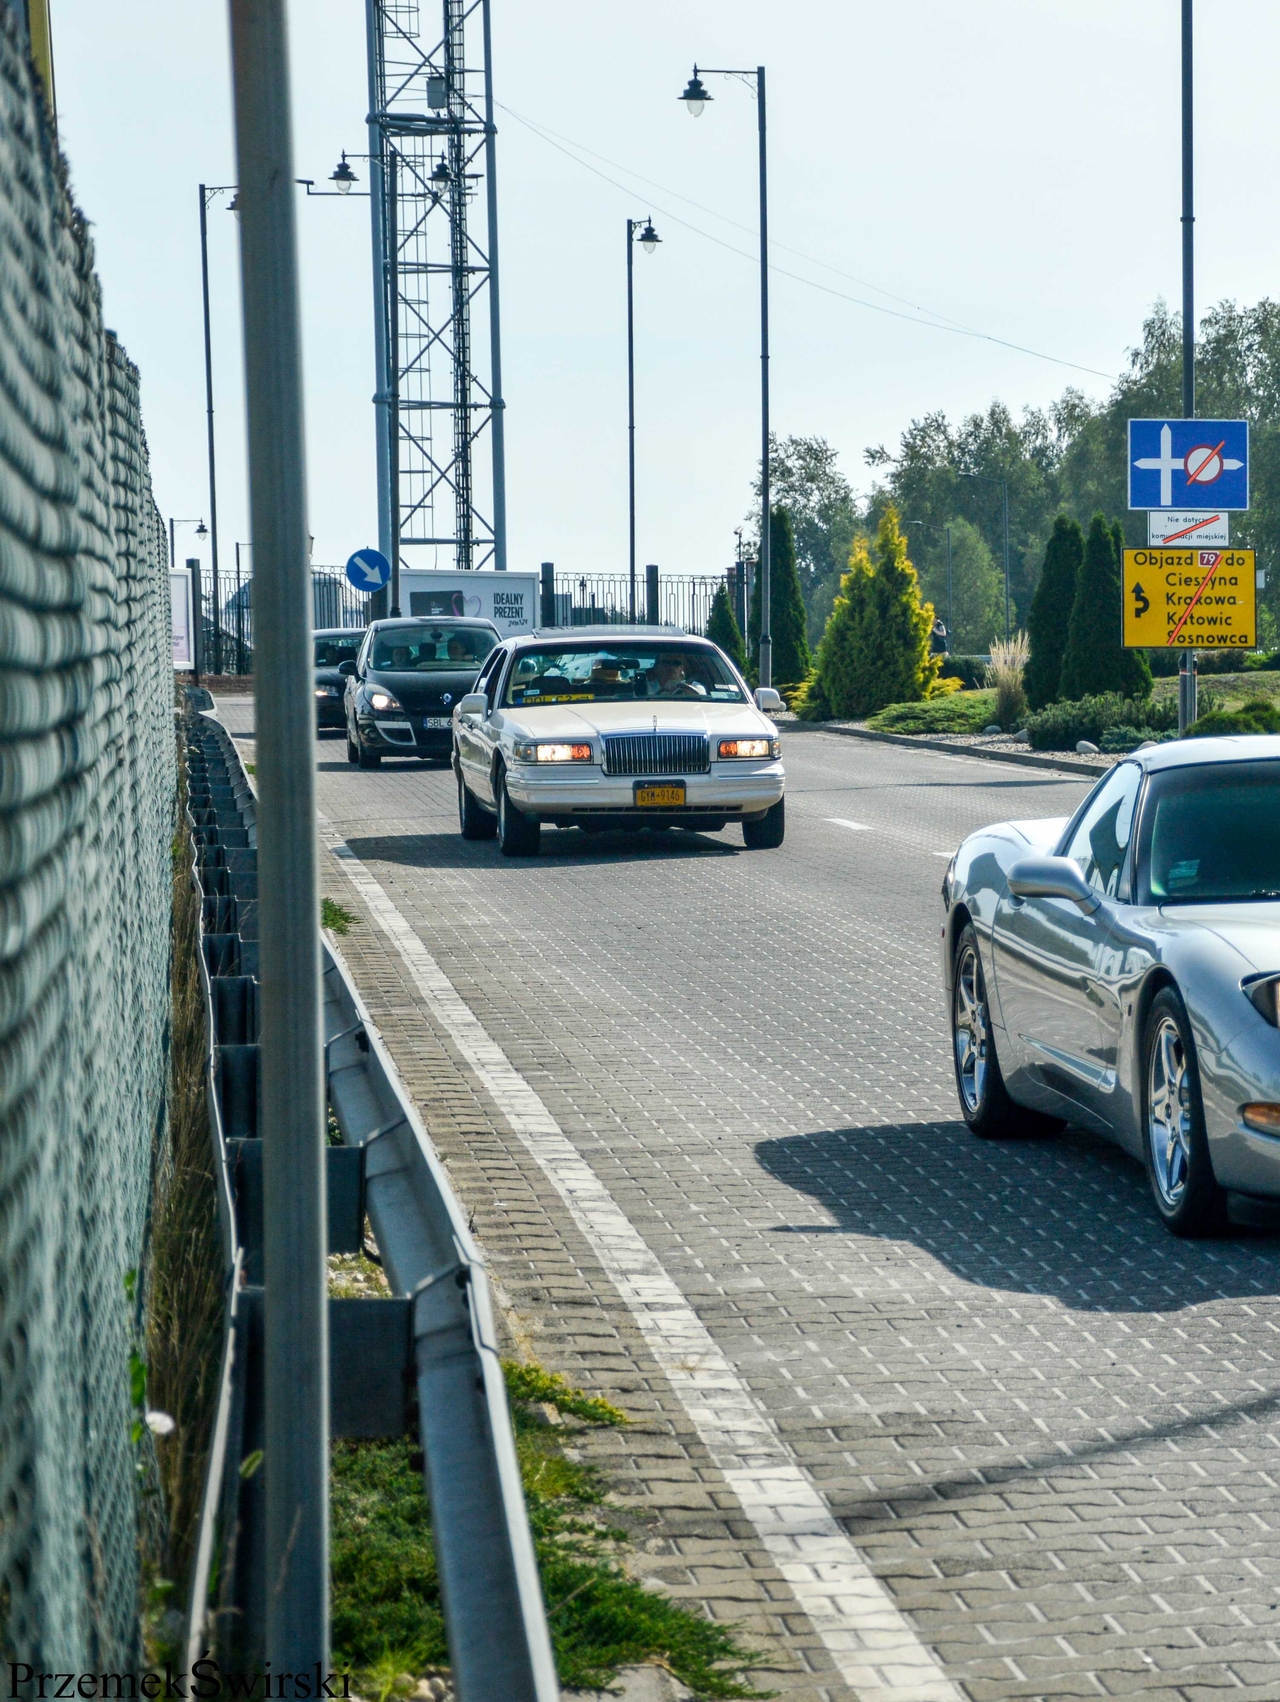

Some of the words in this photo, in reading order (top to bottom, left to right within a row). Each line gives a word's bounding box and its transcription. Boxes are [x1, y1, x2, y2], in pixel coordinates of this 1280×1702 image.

[1196, 533, 1227, 541] miejskiej
[1133, 552, 1194, 569] Objazd
[1201, 554, 1216, 565] 79
[1225, 553, 1246, 566] do
[493, 593, 524, 605] IDEALNY
[1165, 592, 1237, 606] Krakowa
[493, 606, 524, 618] PREZENT
[1166, 612, 1233, 626] Katowic
[427, 718, 444, 727] SBL
